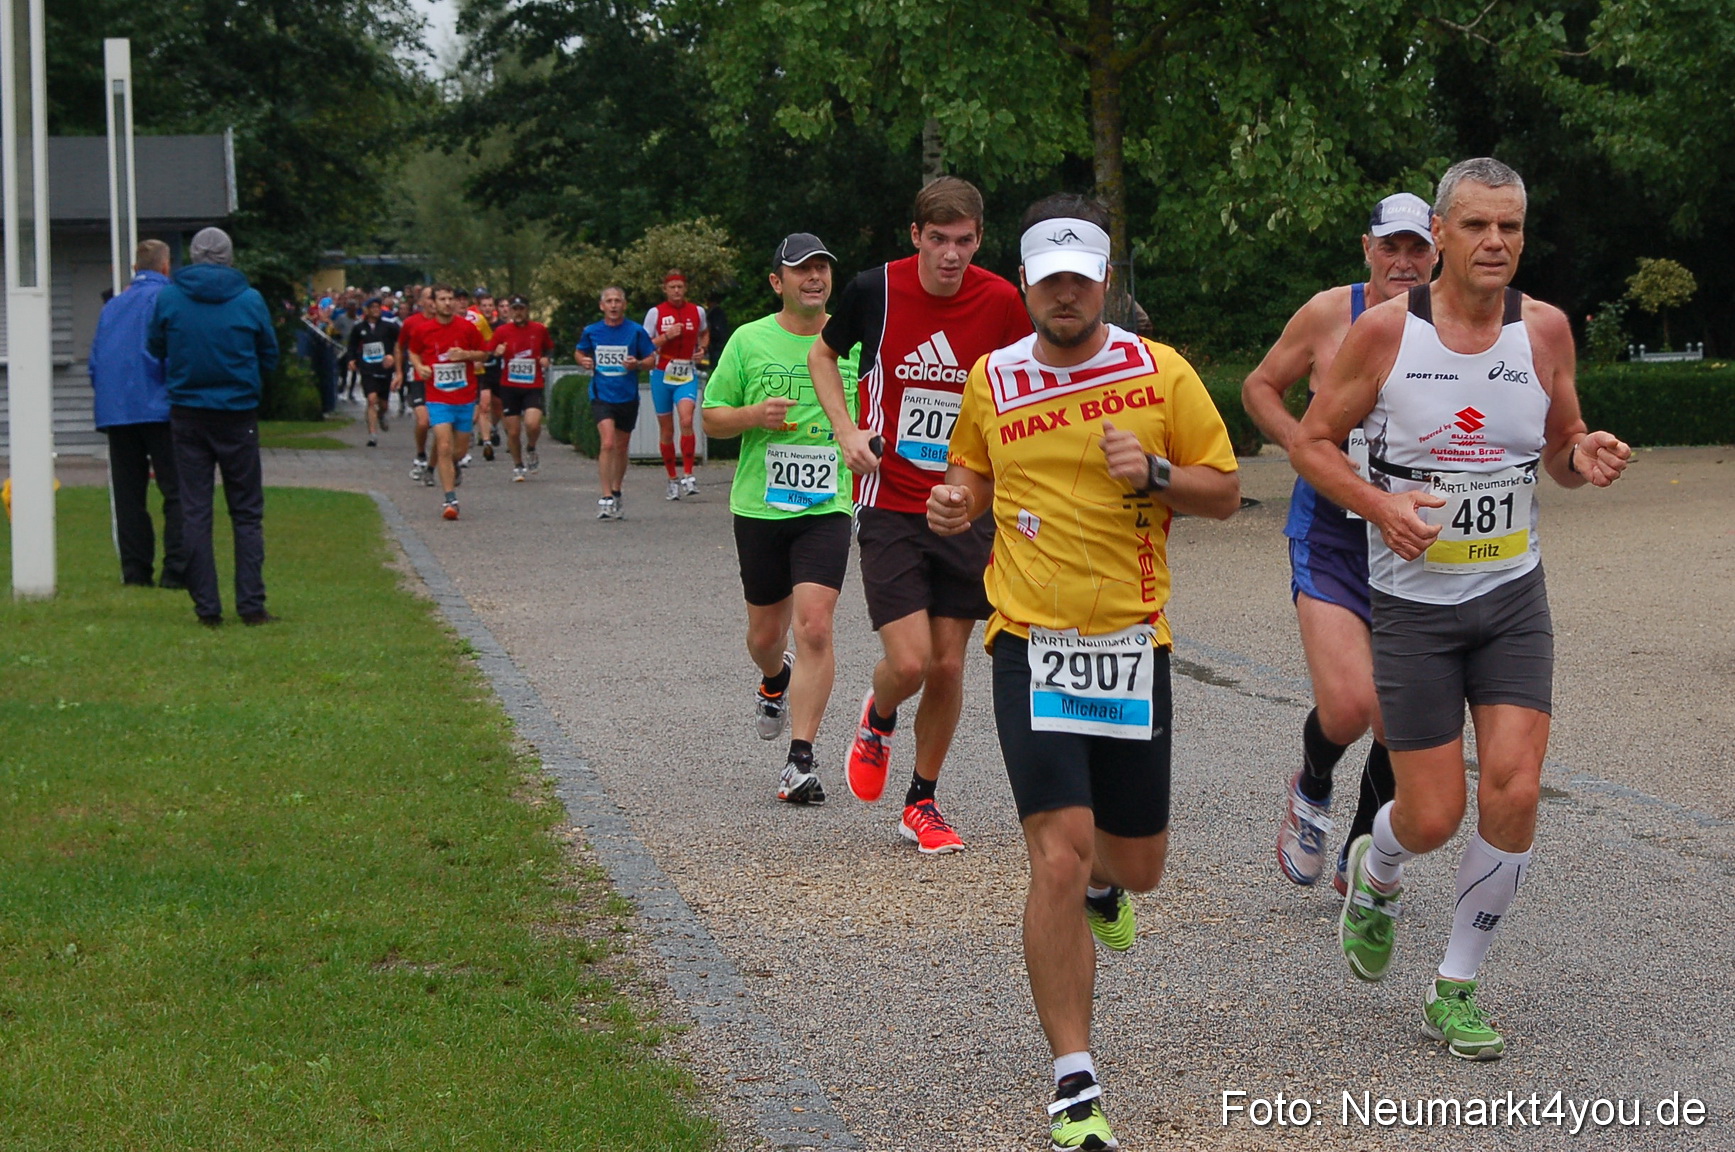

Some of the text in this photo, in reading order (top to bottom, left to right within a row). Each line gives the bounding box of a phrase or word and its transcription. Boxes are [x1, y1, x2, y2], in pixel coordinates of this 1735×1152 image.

[598, 353, 624, 364] 2553
[438, 370, 462, 381] 2331
[894, 362, 968, 384] adidas
[1503, 369, 1528, 384] asics
[904, 395, 932, 406] PARTL
[1000, 385, 1165, 446] MAX BÖGL
[1351, 438, 1367, 446] PA
[1418, 426, 1443, 444] Powered
[767, 450, 826, 460] PARTL Neumarkt
[772, 461, 831, 489] 2032
[1434, 478, 1520, 494] PARTL Neumarkt
[788, 492, 812, 506] Klaus
[1452, 492, 1514, 535] 481
[1469, 544, 1499, 559] Fritz
[1031, 632, 1131, 648] PARTL Neumarkt
[1042, 650, 1142, 692] 2907
[1061, 698, 1123, 720] Michael
